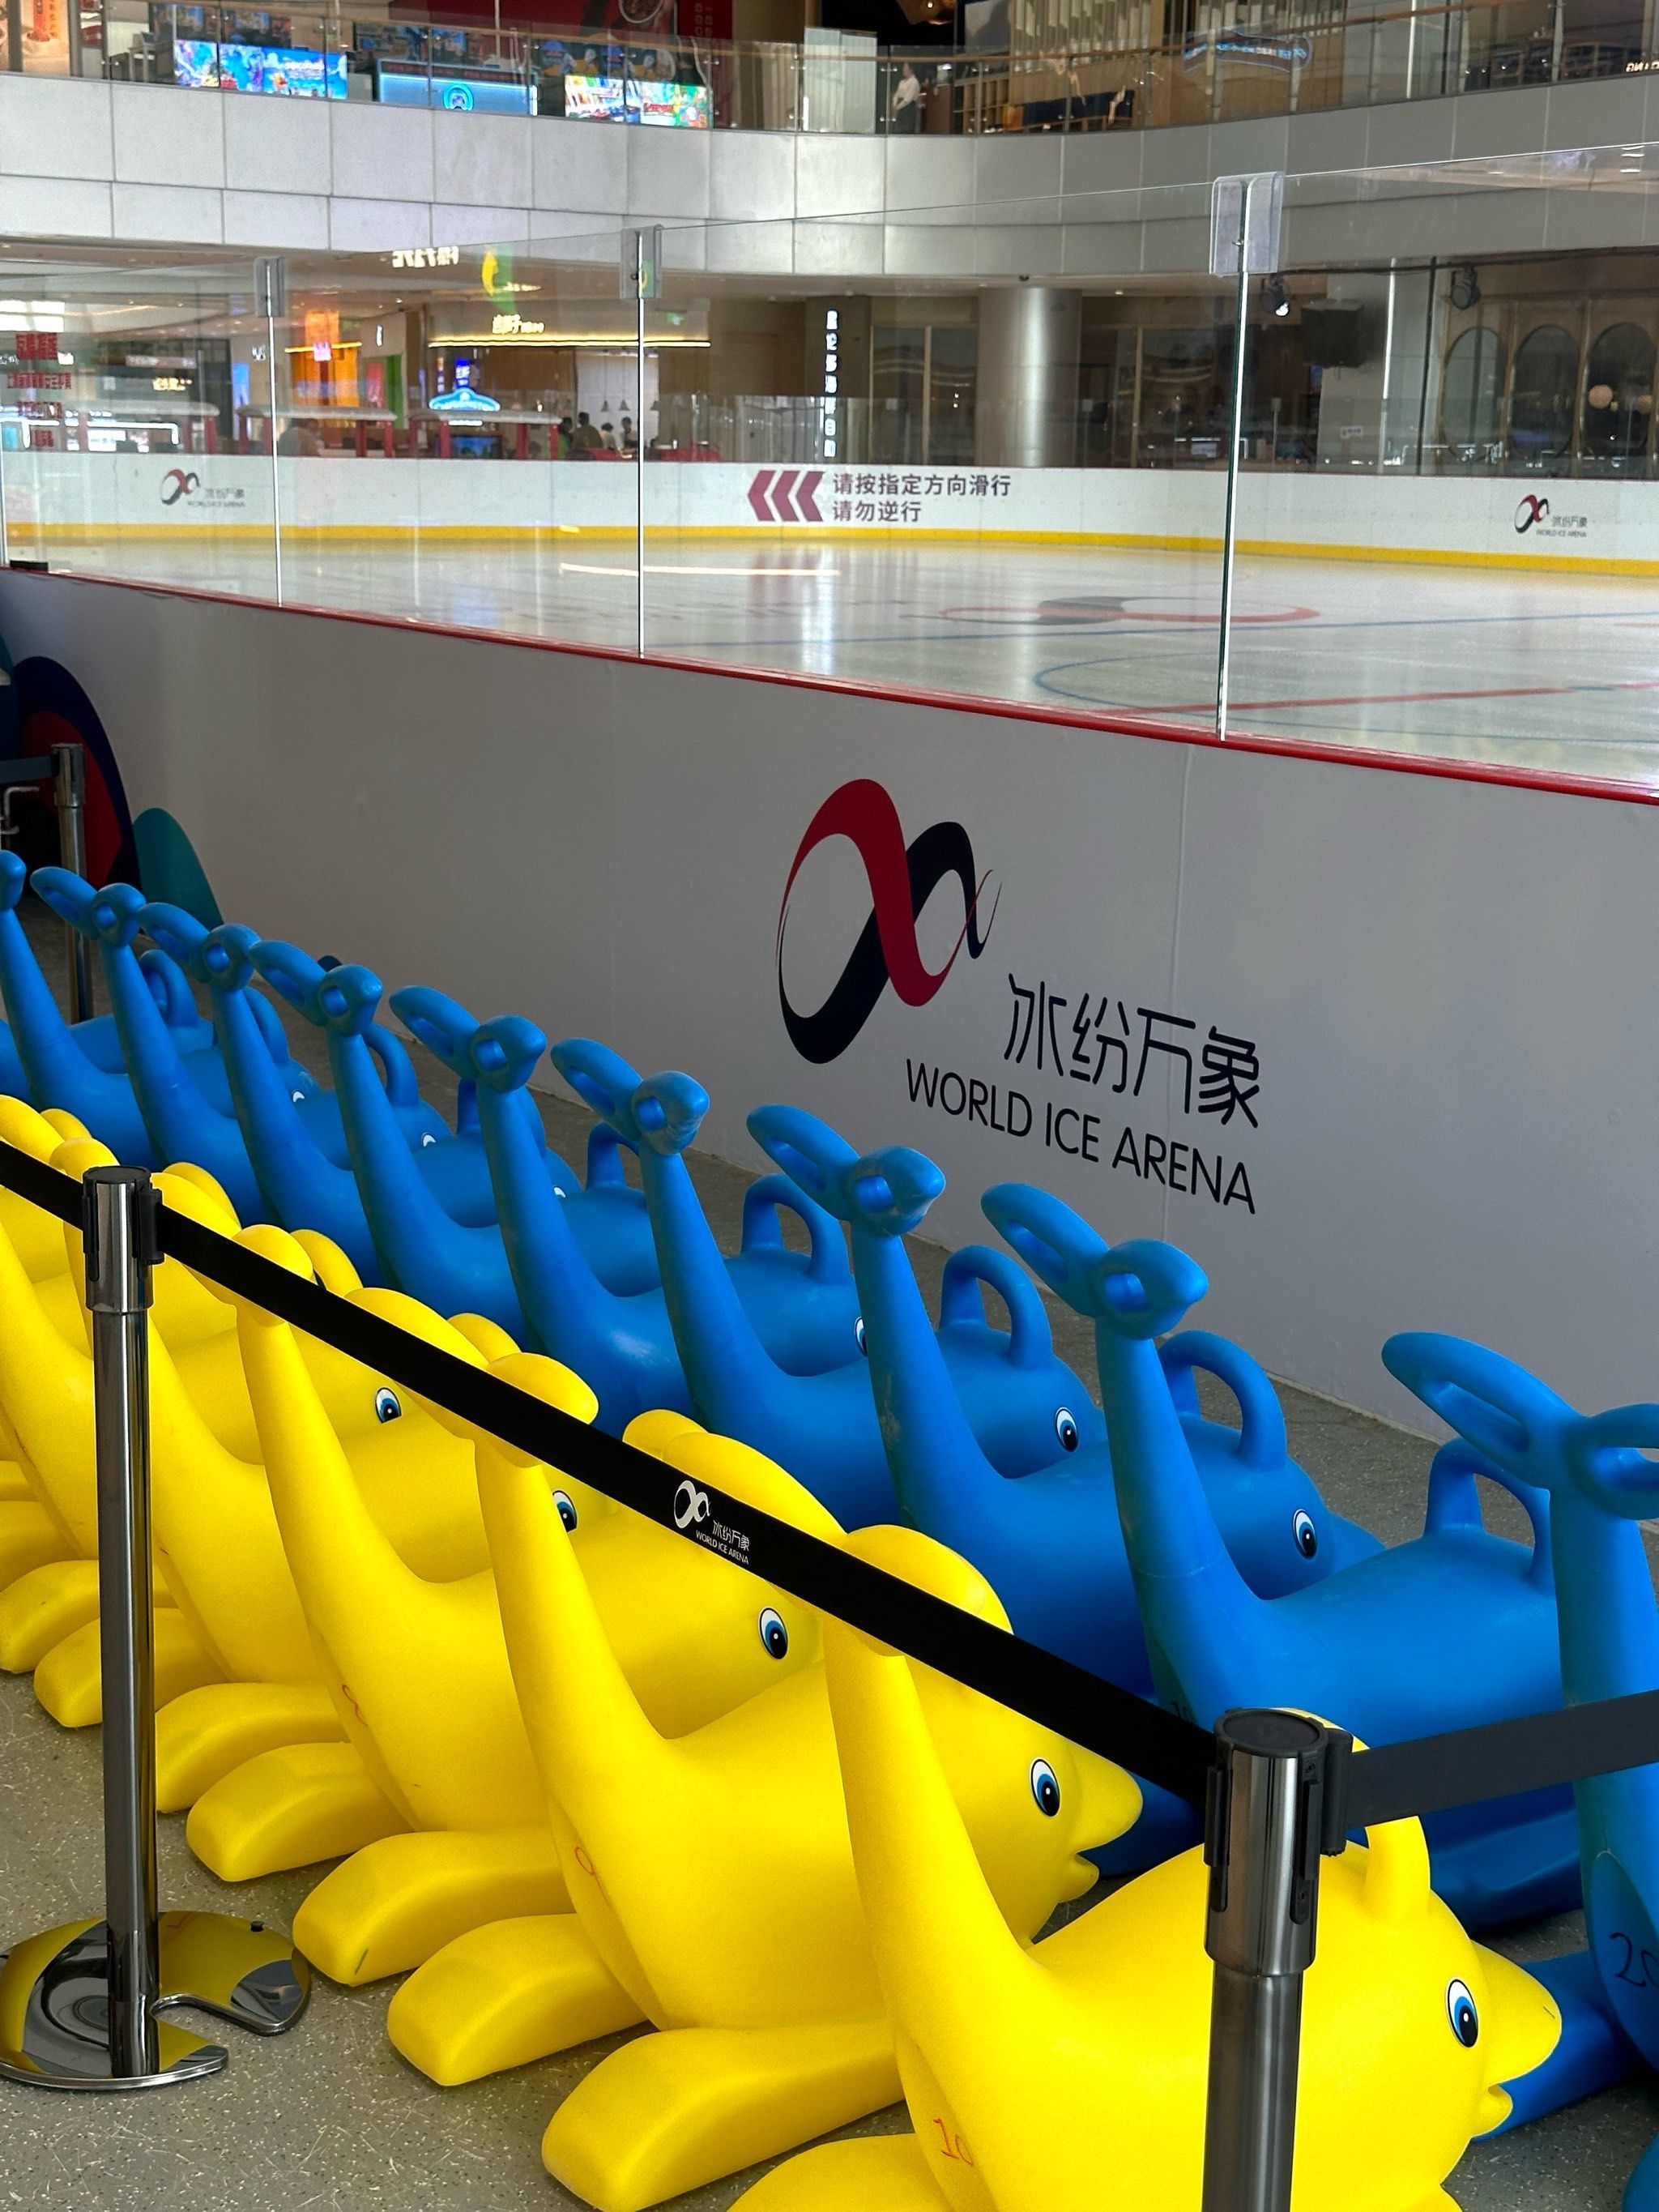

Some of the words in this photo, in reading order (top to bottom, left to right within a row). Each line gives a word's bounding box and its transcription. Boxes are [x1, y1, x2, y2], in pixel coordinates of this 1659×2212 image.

[832, 473, 1011, 497] 请按指定方向滑行
[833, 501, 922, 523] 请勿逆行
[1004, 972, 1260, 1128] 冰纷万象
[906, 1058, 1033, 1137] WORLD
[1045, 1102, 1101, 1162] ICE
[1112, 1126, 1255, 1215] ARENA
[696, 1530, 718, 1548] WORLD
[718, 1542, 728, 1554] ICE
[728, 1548, 749, 1565] ARENA
[713, 1519, 750, 1552] 冰纷万象
[932, 2116, 975, 2167] 10
